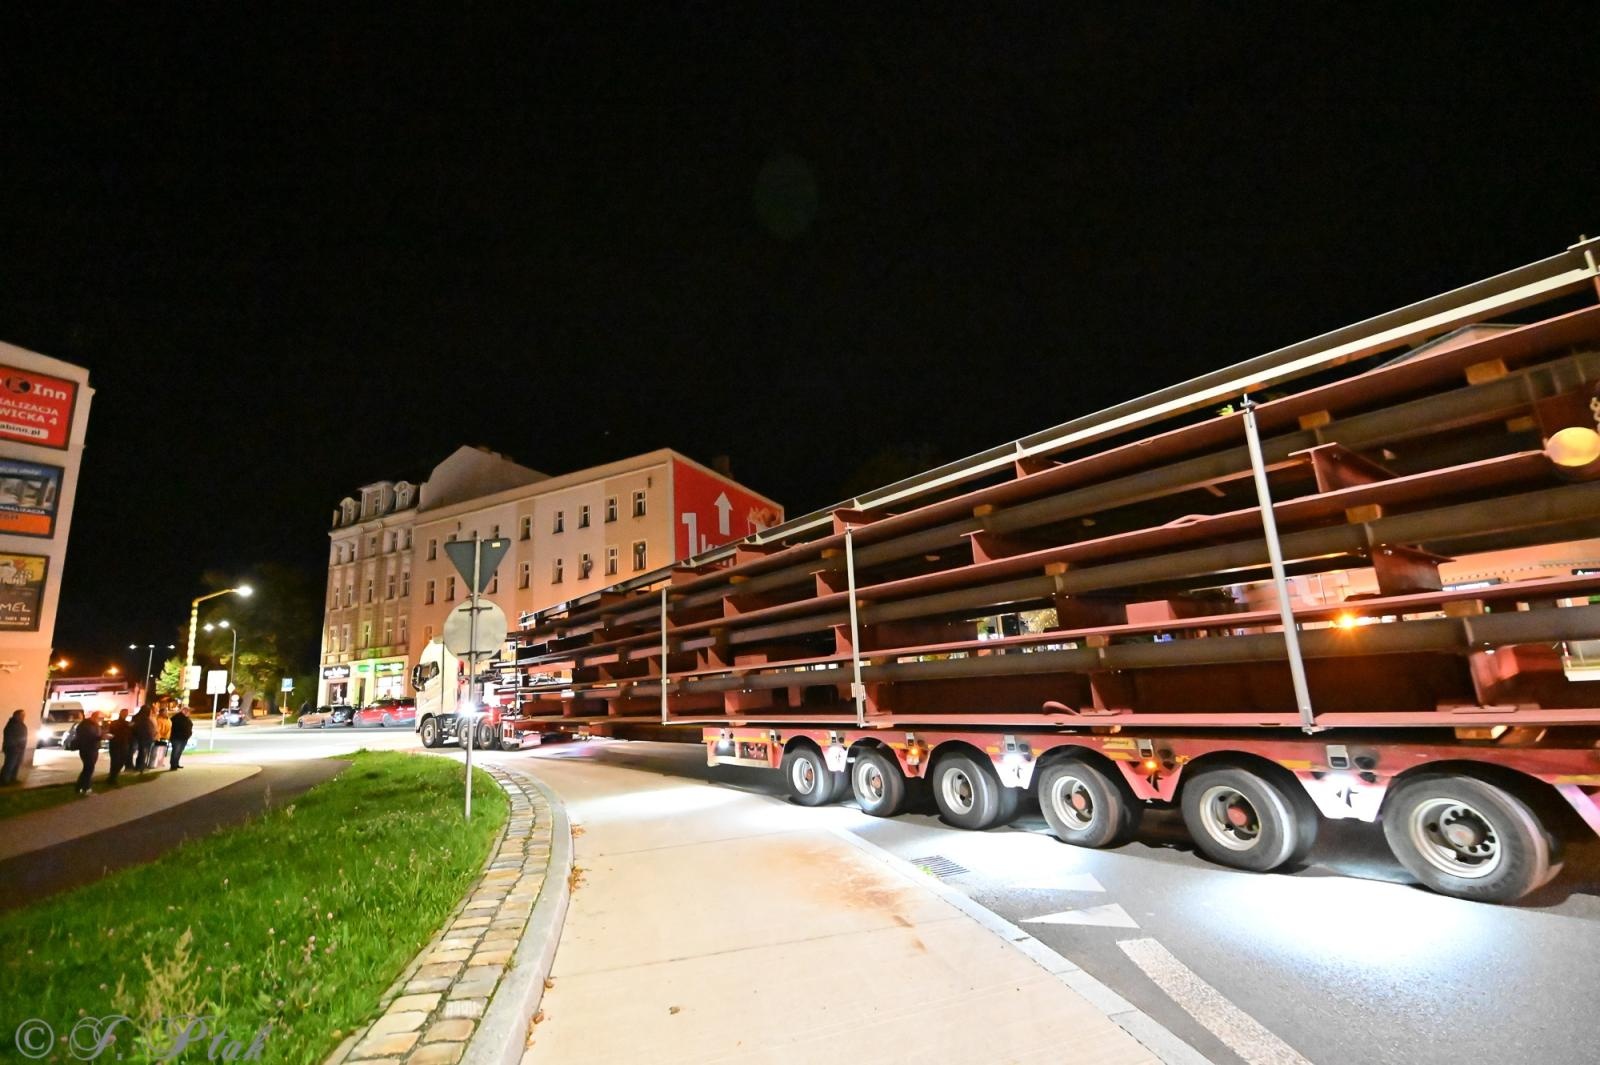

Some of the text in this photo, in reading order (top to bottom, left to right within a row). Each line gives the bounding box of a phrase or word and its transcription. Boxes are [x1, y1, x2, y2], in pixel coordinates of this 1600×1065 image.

[33, 383, 68, 401] Inn
[48, 417, 58, 426] 4
[681, 512, 698, 559] 1
